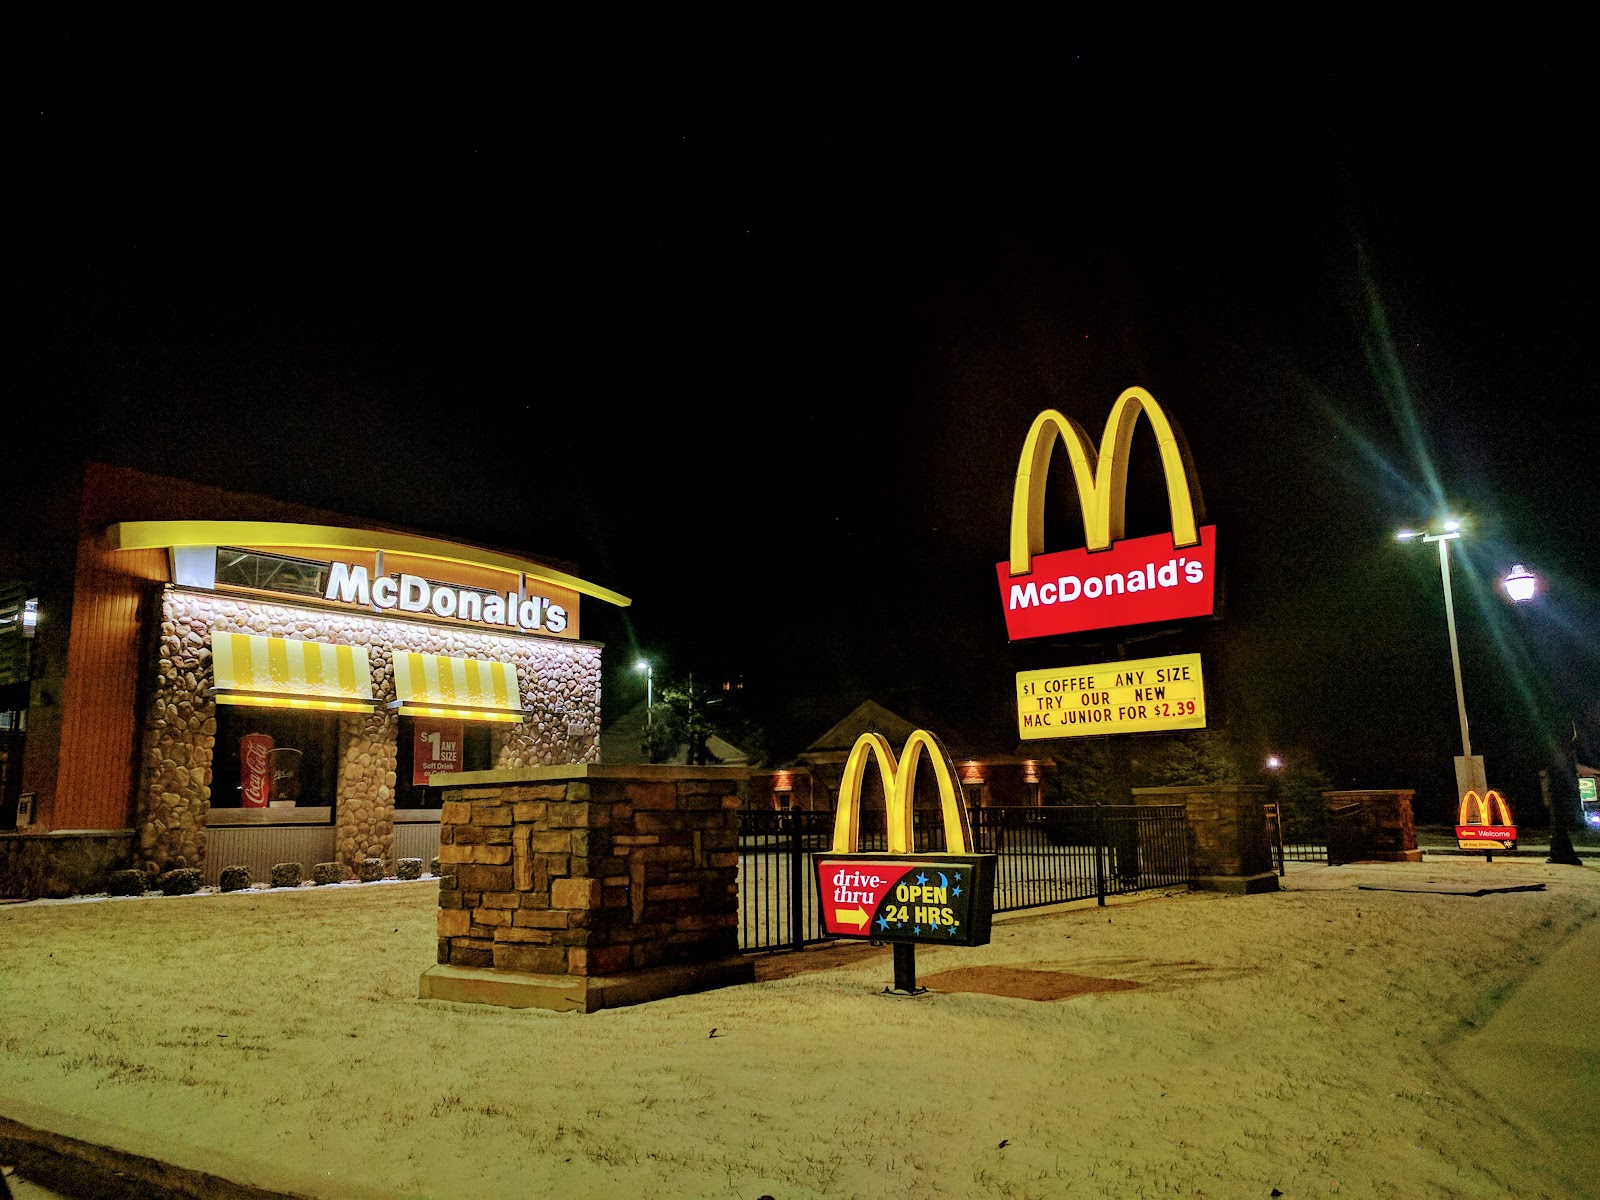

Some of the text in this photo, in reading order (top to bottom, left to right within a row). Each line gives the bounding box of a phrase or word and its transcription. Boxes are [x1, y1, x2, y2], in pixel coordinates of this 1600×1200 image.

[1008, 557, 1205, 611] McDonald's
[324, 561, 568, 634] McDonald's
[1043, 676, 1096, 694] COFFEE
[1115, 671, 1145, 688] ANY
[1156, 666, 1192, 683] SIZE
[1036, 686, 1167, 710] TRY OUR NEW
[1023, 700, 1196, 728] MAC JUNIOR FOR $2.39
[440, 751, 457, 762] SIZE
[441, 741, 457, 752] ANY
[422, 762, 455, 770] Soft Drink
[1477, 830, 1511, 838] Welcome
[833, 869, 888, 887] drive-
[833, 885, 875, 905] thru
[896, 884, 948, 905] OPEN
[885, 905, 960, 927] 24 HRS.
